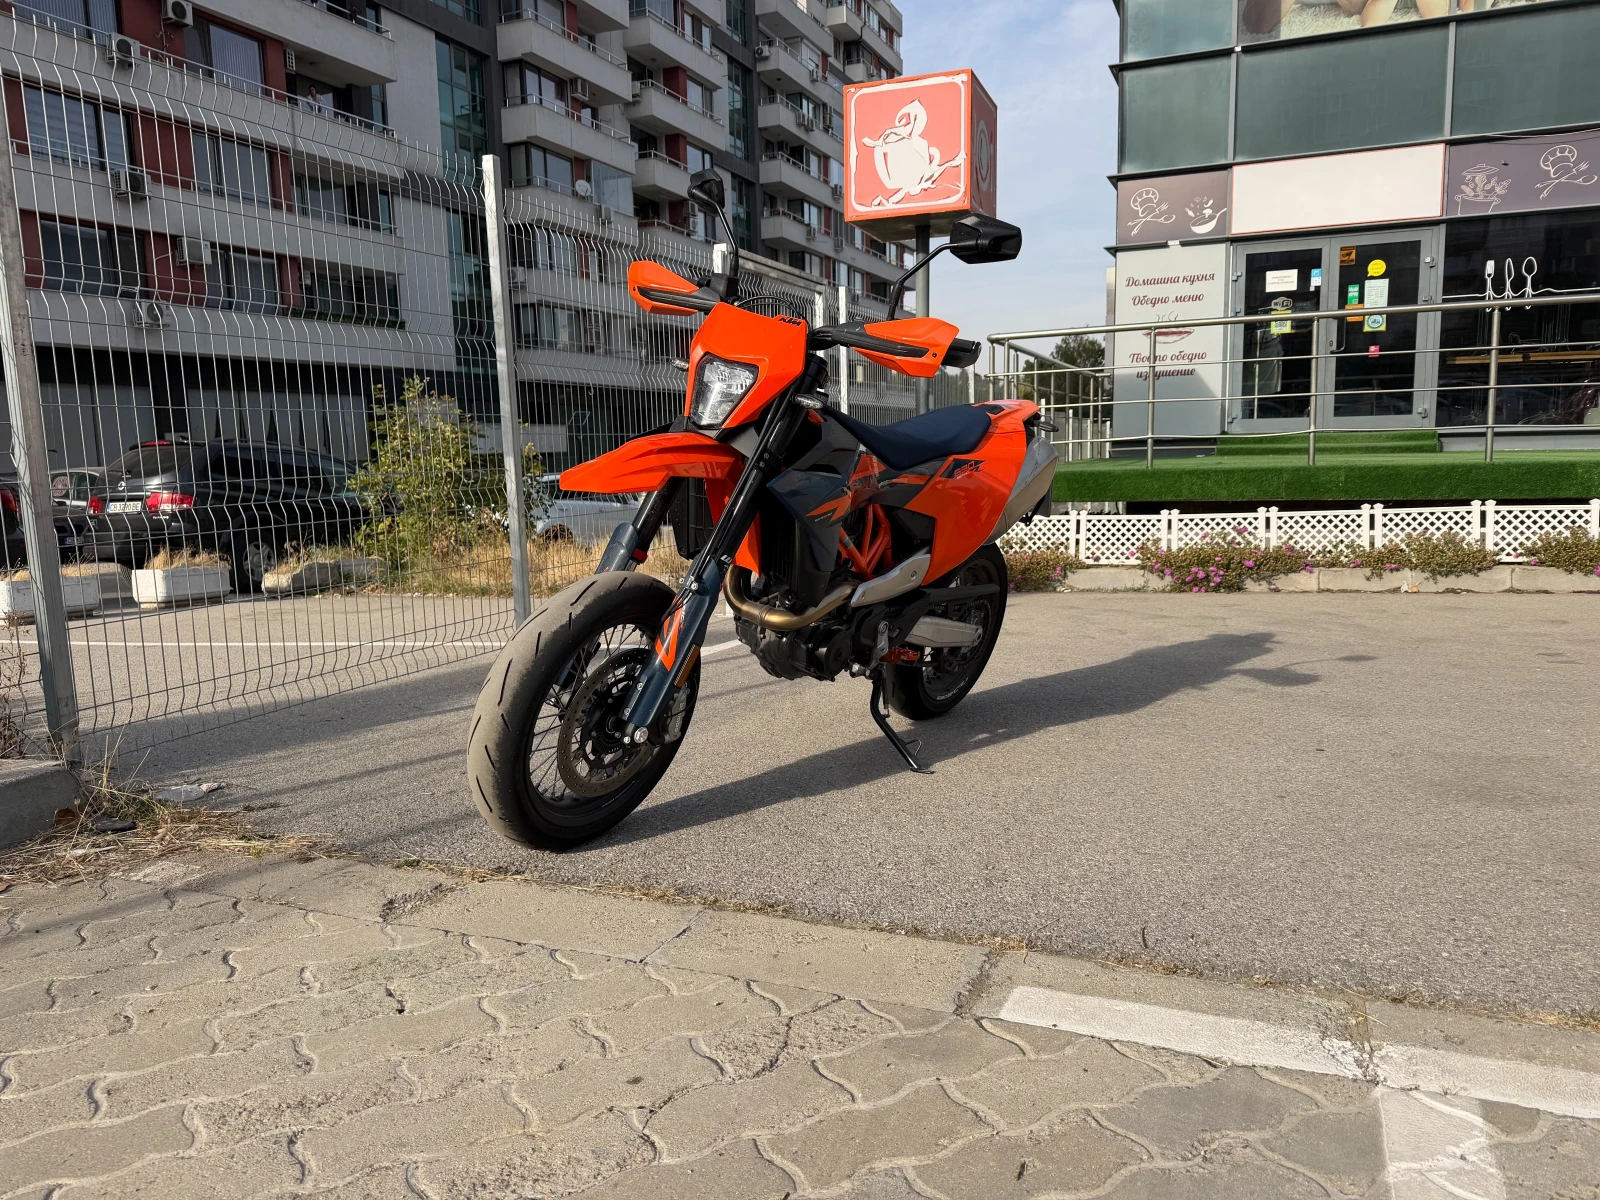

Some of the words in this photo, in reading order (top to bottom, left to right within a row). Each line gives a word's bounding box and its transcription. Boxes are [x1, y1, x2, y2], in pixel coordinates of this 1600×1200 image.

[1125, 276, 1181, 287] Домашна
[1182, 273, 1215, 285] кухня
[1132, 295, 1170, 308] Обедно
[1172, 293, 1204, 303] меню
[778, 317, 802, 326] KTM
[1170, 350, 1207, 363] обедно
[1136, 368, 1196, 381] изушение
